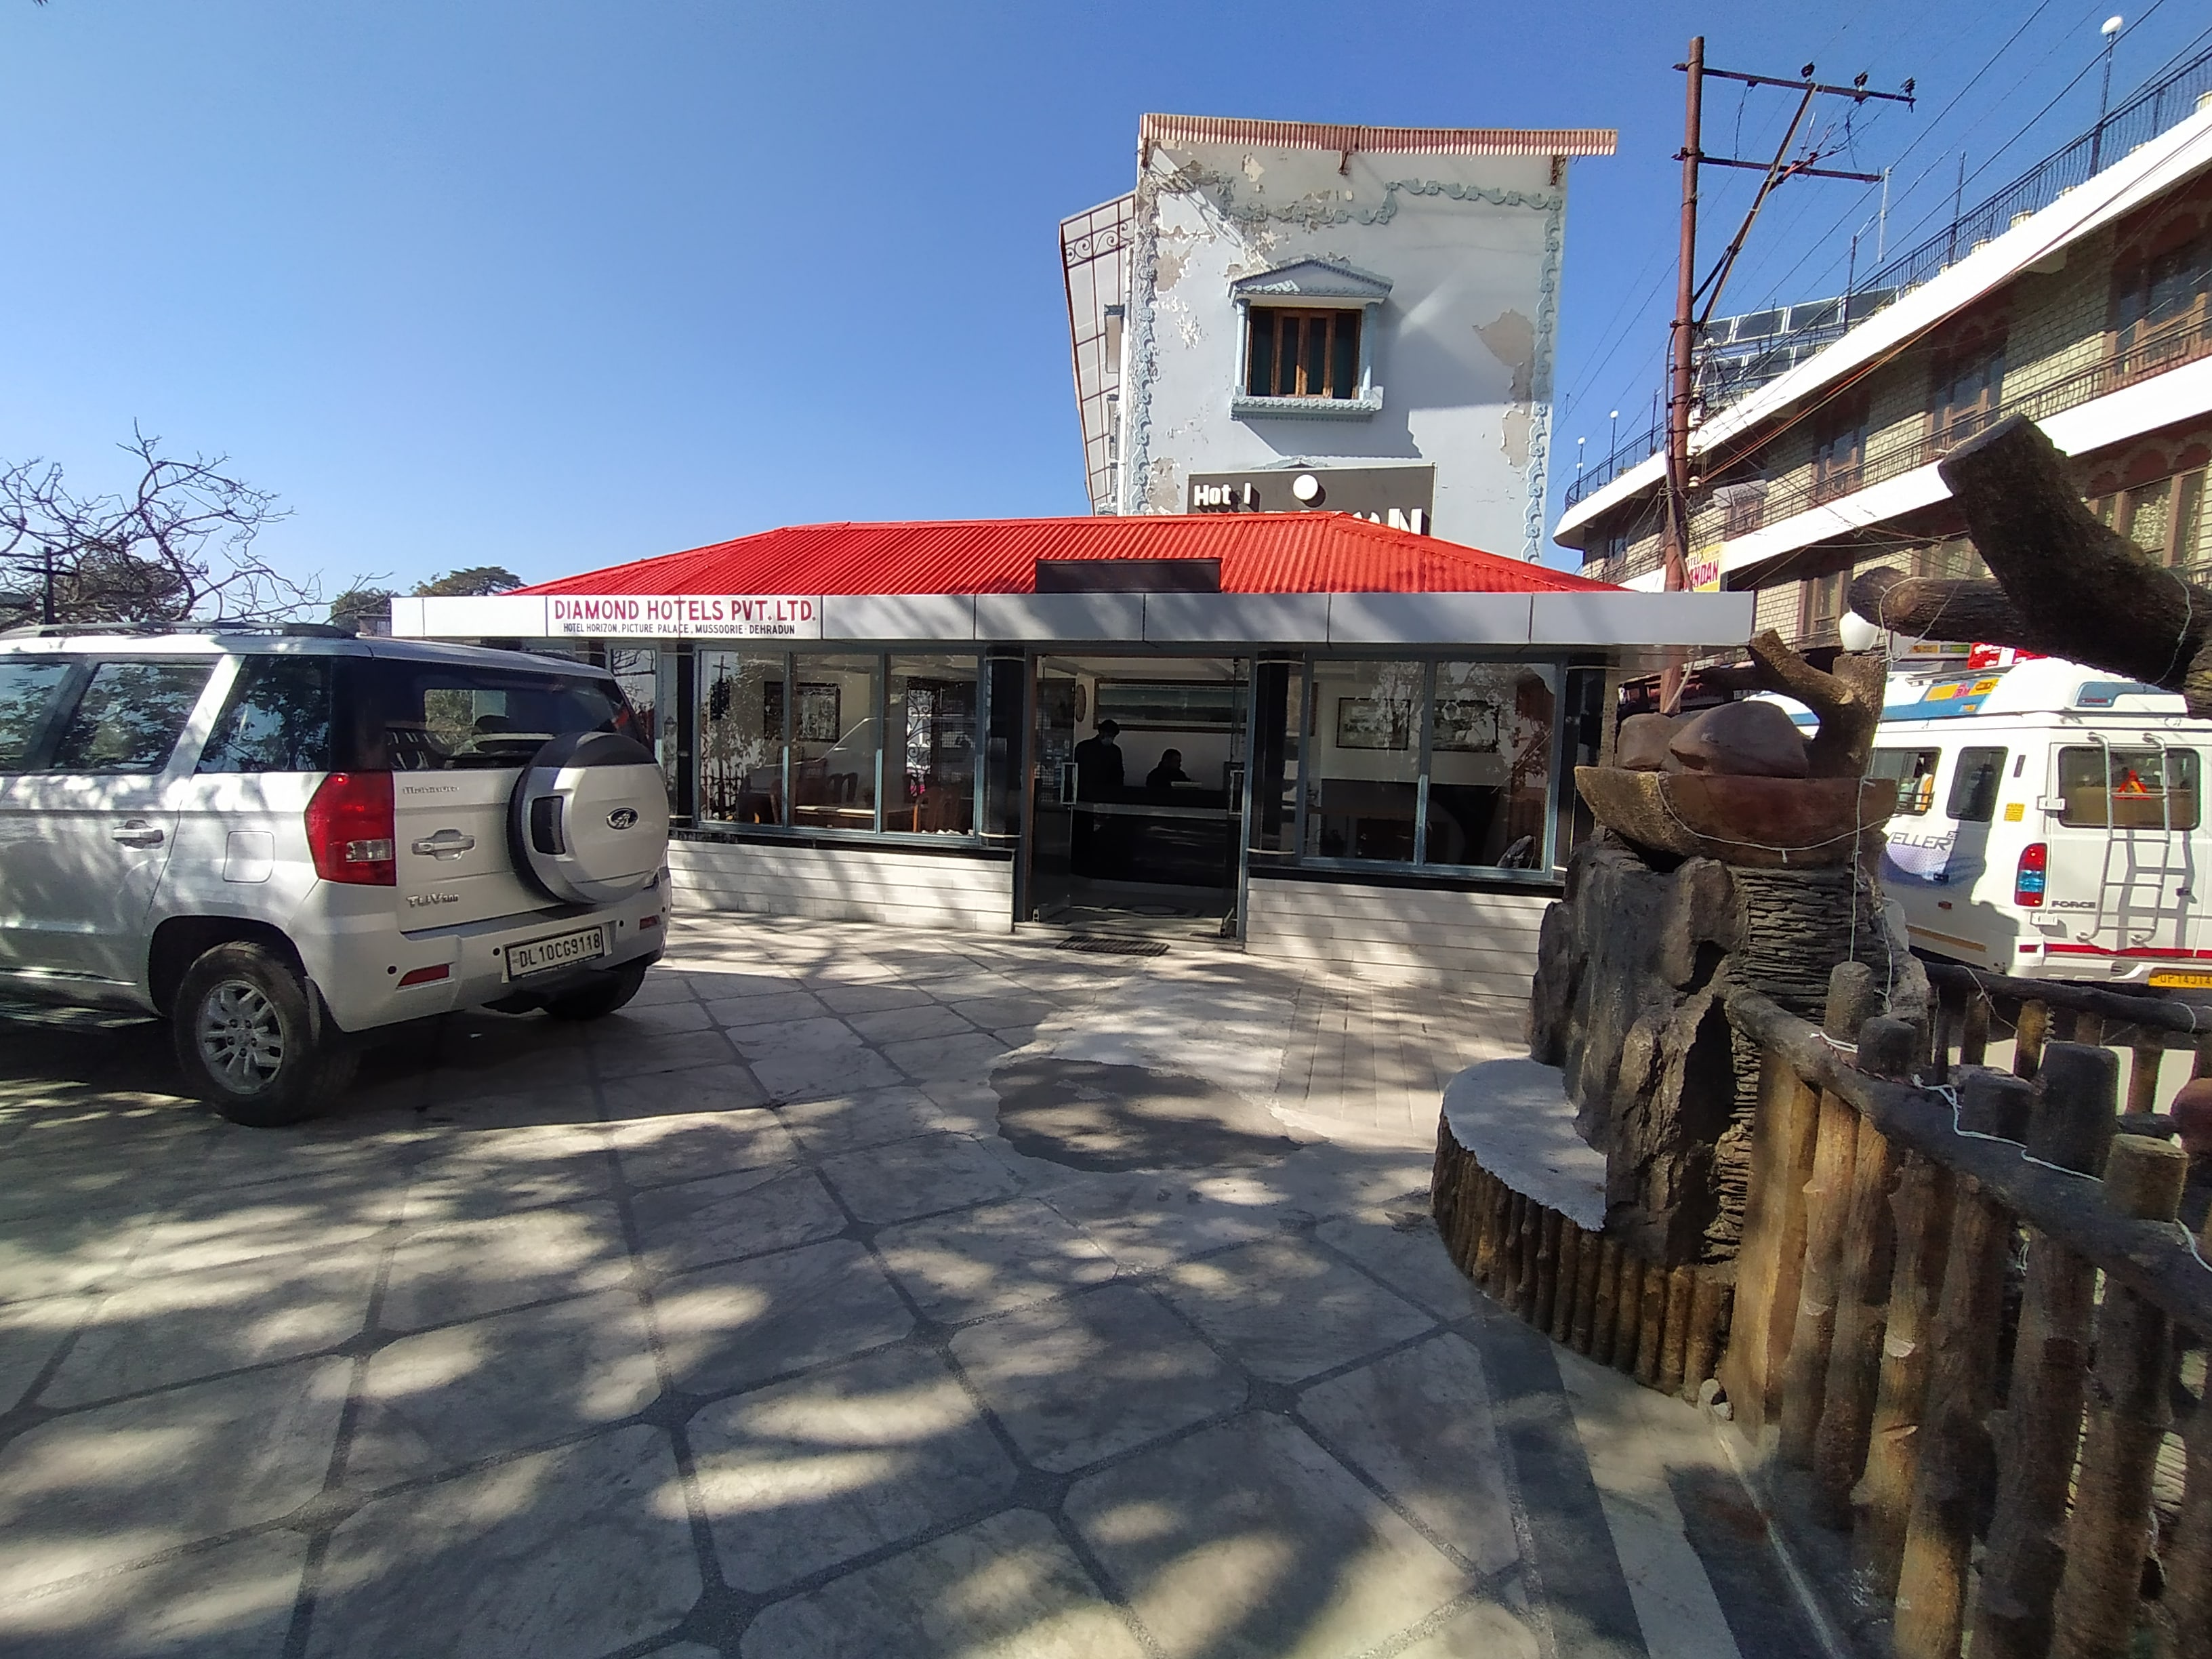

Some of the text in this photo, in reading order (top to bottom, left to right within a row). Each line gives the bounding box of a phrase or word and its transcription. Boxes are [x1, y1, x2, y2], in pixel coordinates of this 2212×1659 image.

[554, 600, 817, 621] DIAMOND HOTELS PVT. LTD.
[563, 623, 584, 633] HOTEL
[621, 623, 653, 634] PICTURE
[695, 624, 743, 634] MUSSOORIE
[749, 624, 795, 635] DEHRADUN
[2051, 900, 2096, 909] FORCE
